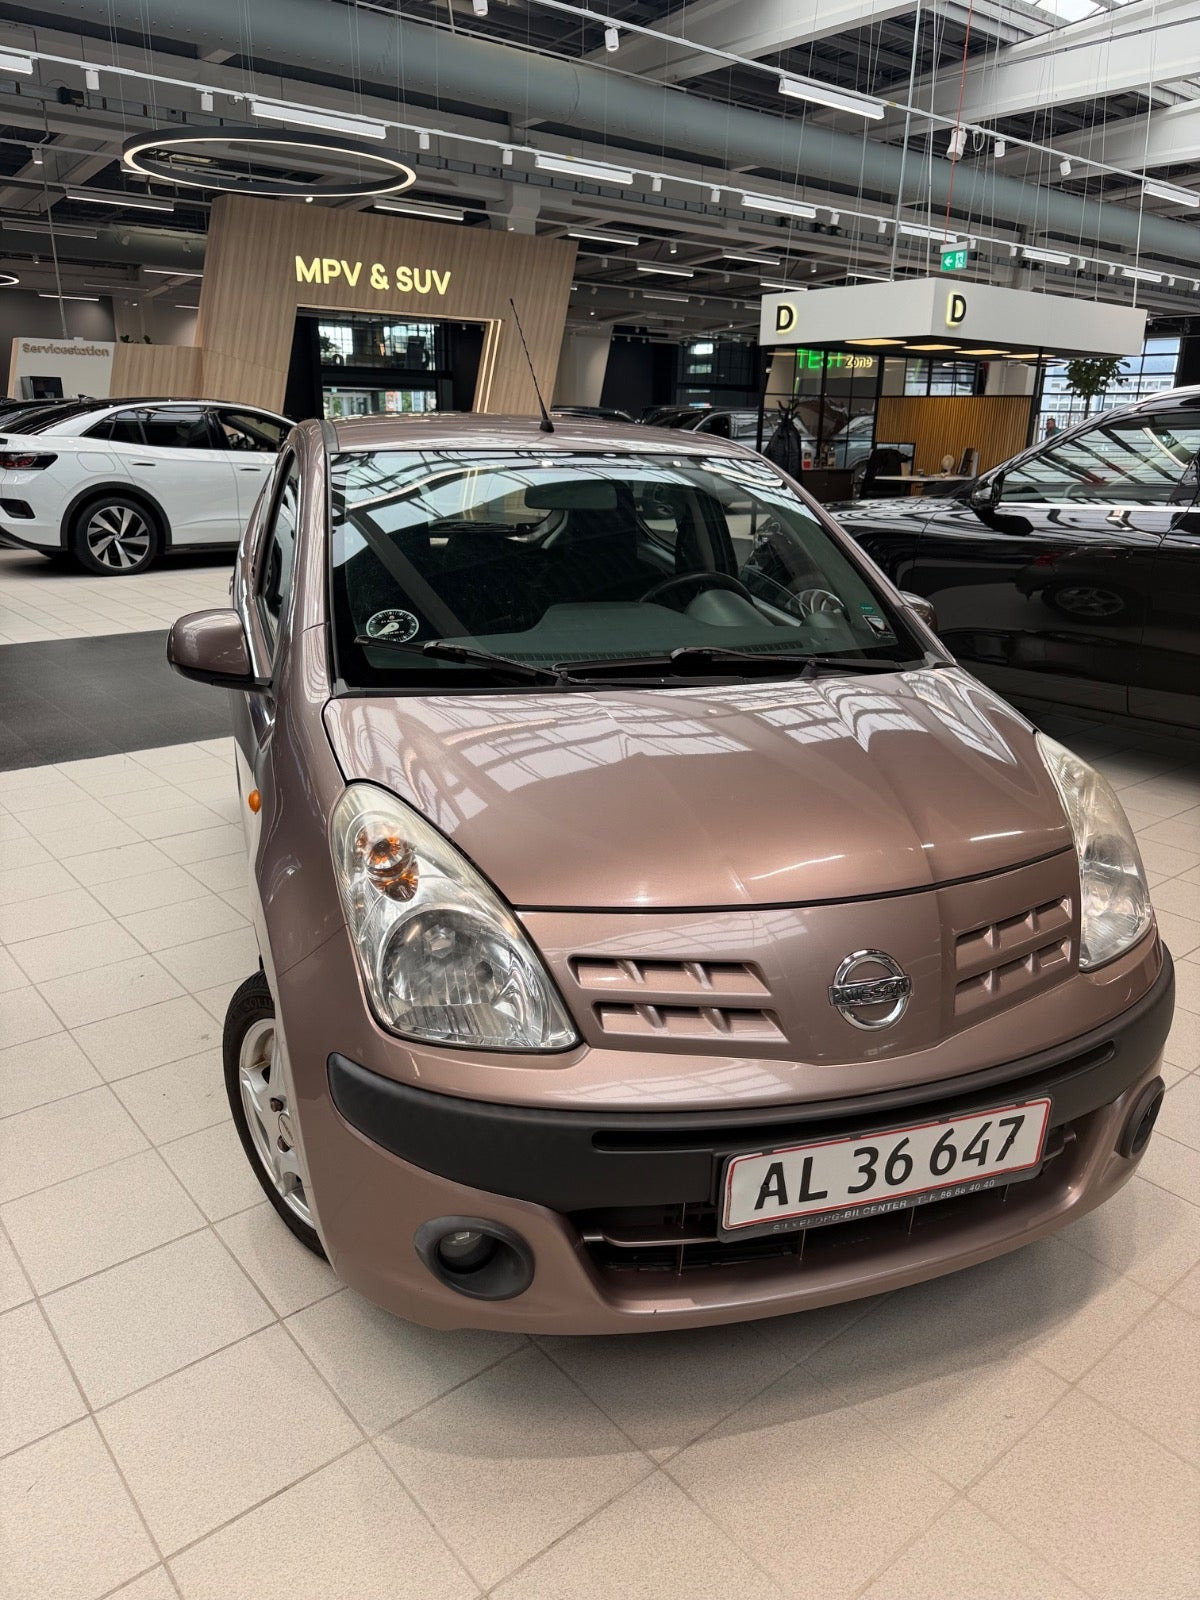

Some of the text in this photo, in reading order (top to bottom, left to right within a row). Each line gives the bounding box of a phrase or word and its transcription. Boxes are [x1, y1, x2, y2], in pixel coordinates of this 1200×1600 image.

[295, 255, 452, 295] MPV & SUV
[775, 304, 796, 333] D
[948, 293, 967, 324] D
[22, 342, 110, 357] Servicestation
[845, 354, 873, 369] Zone
[753, 1114, 1026, 1210] AL 36 647
